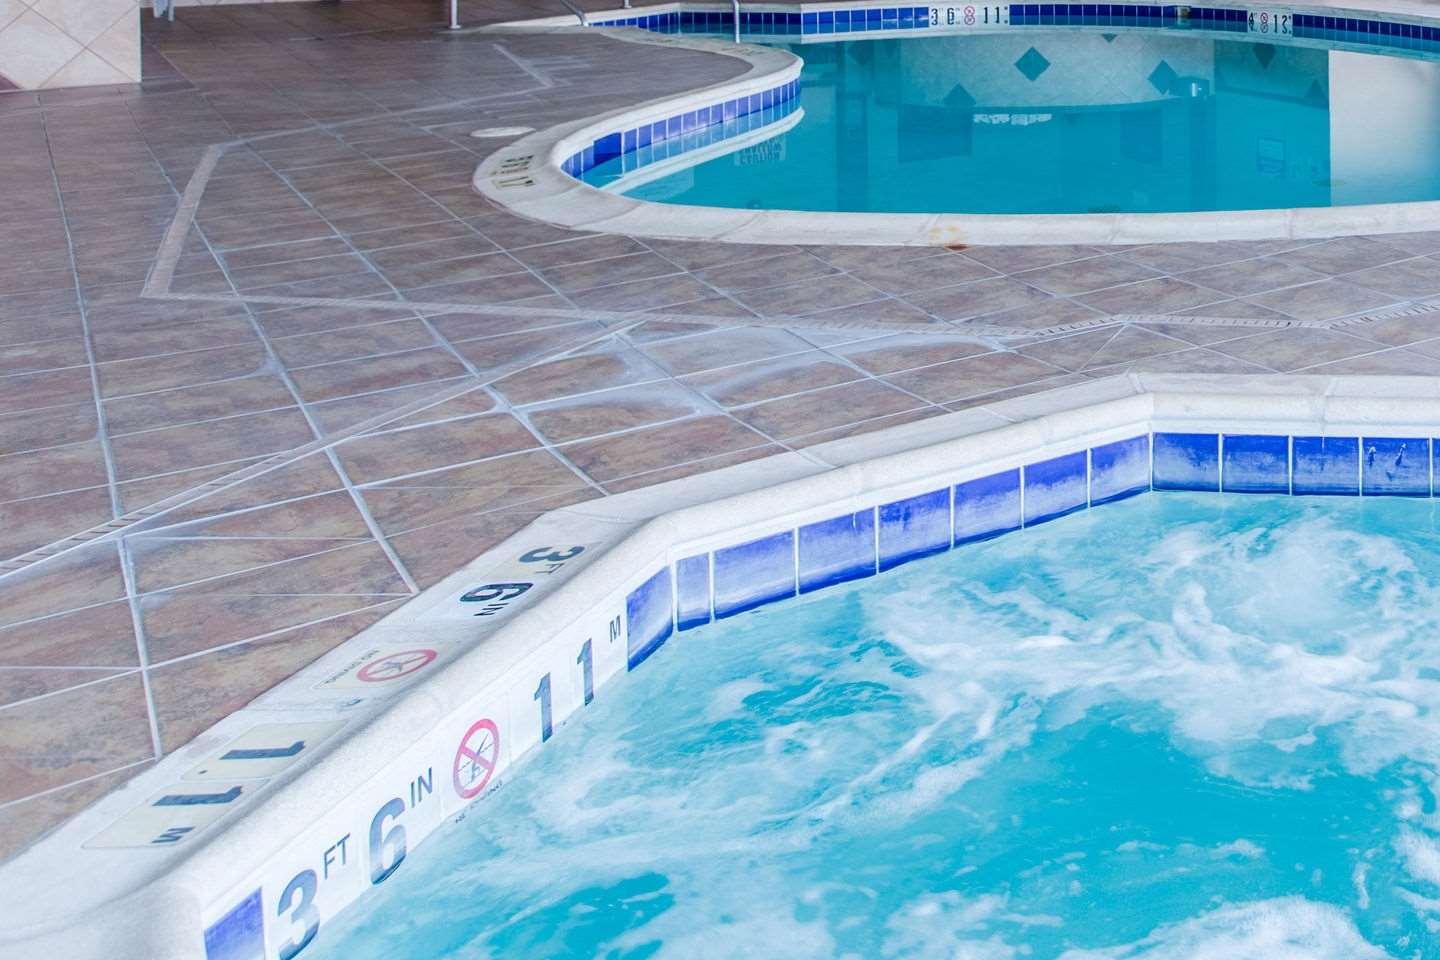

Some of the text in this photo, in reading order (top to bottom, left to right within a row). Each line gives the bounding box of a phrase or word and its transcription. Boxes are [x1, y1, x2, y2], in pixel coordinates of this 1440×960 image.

[519, 546, 585, 563] 3
[459, 582, 534, 602] 6
[609, 615, 621, 644] M
[152, 826, 195, 844] M
[278, 766, 433, 960] 3 FT 6 IN
